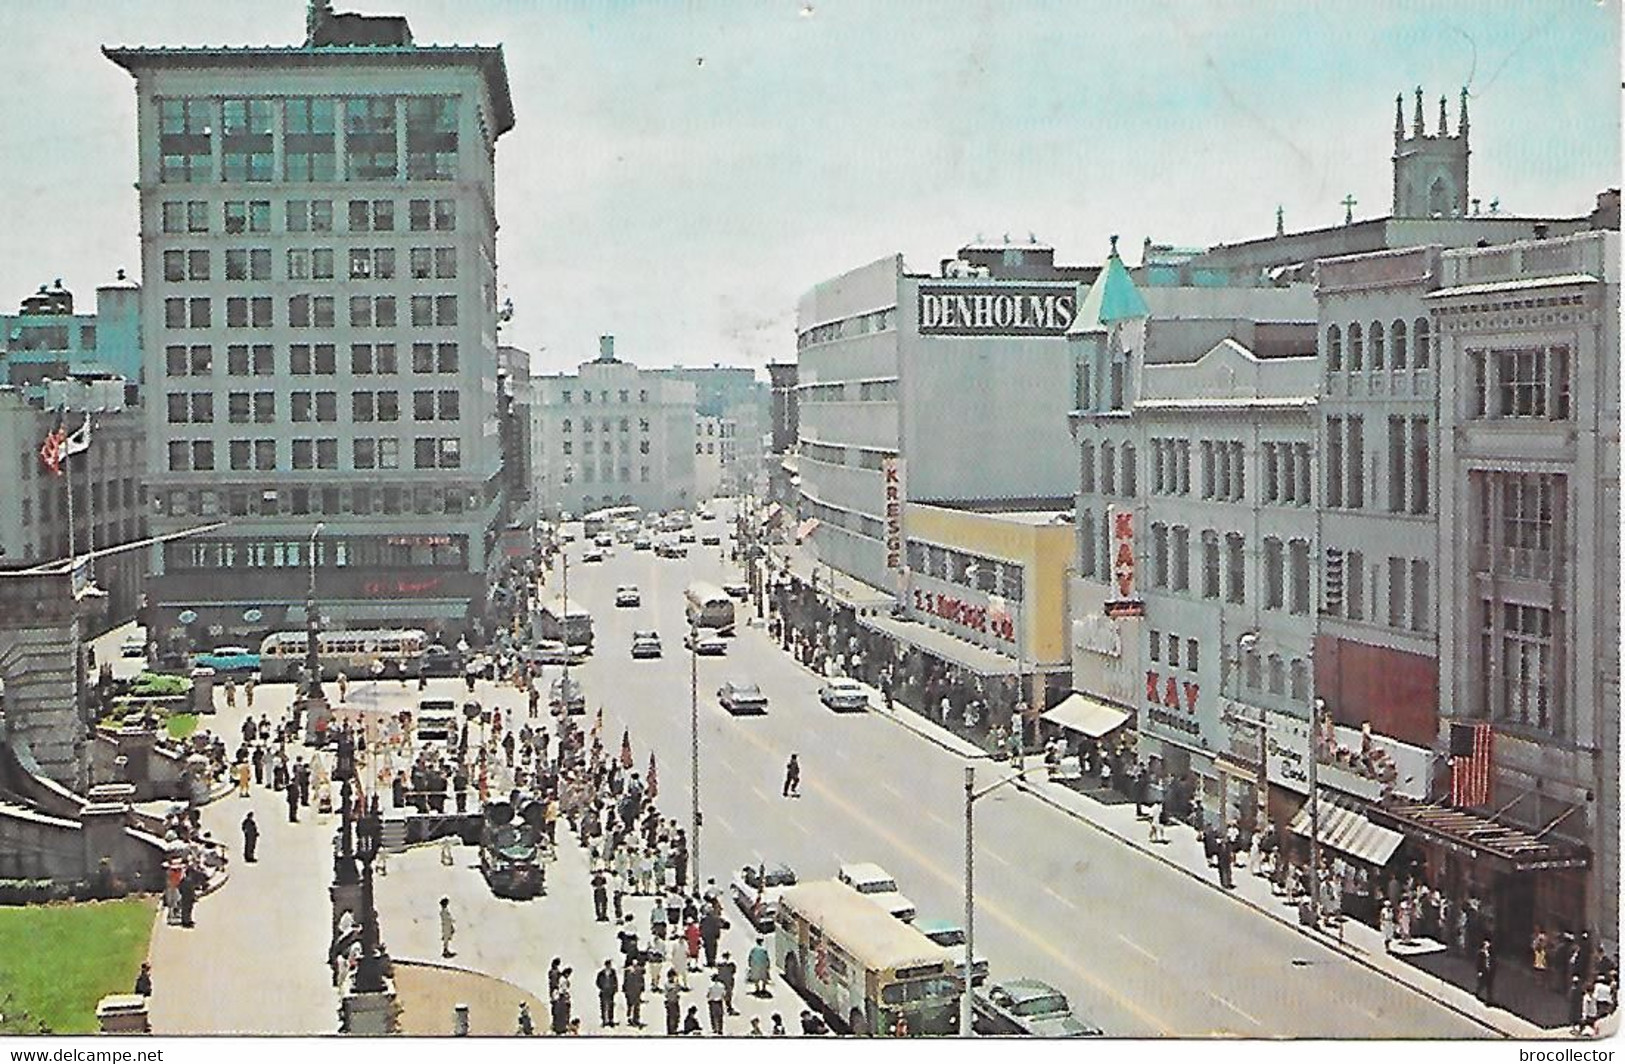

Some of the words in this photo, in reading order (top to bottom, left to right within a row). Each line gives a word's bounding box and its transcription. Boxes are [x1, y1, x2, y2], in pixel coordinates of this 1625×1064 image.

[921, 294, 1073, 329] DENHOLMS
[886, 467, 900, 568] KRESGE
[1115, 513, 1134, 597] KAY
[1146, 670, 1200, 715] KAY
